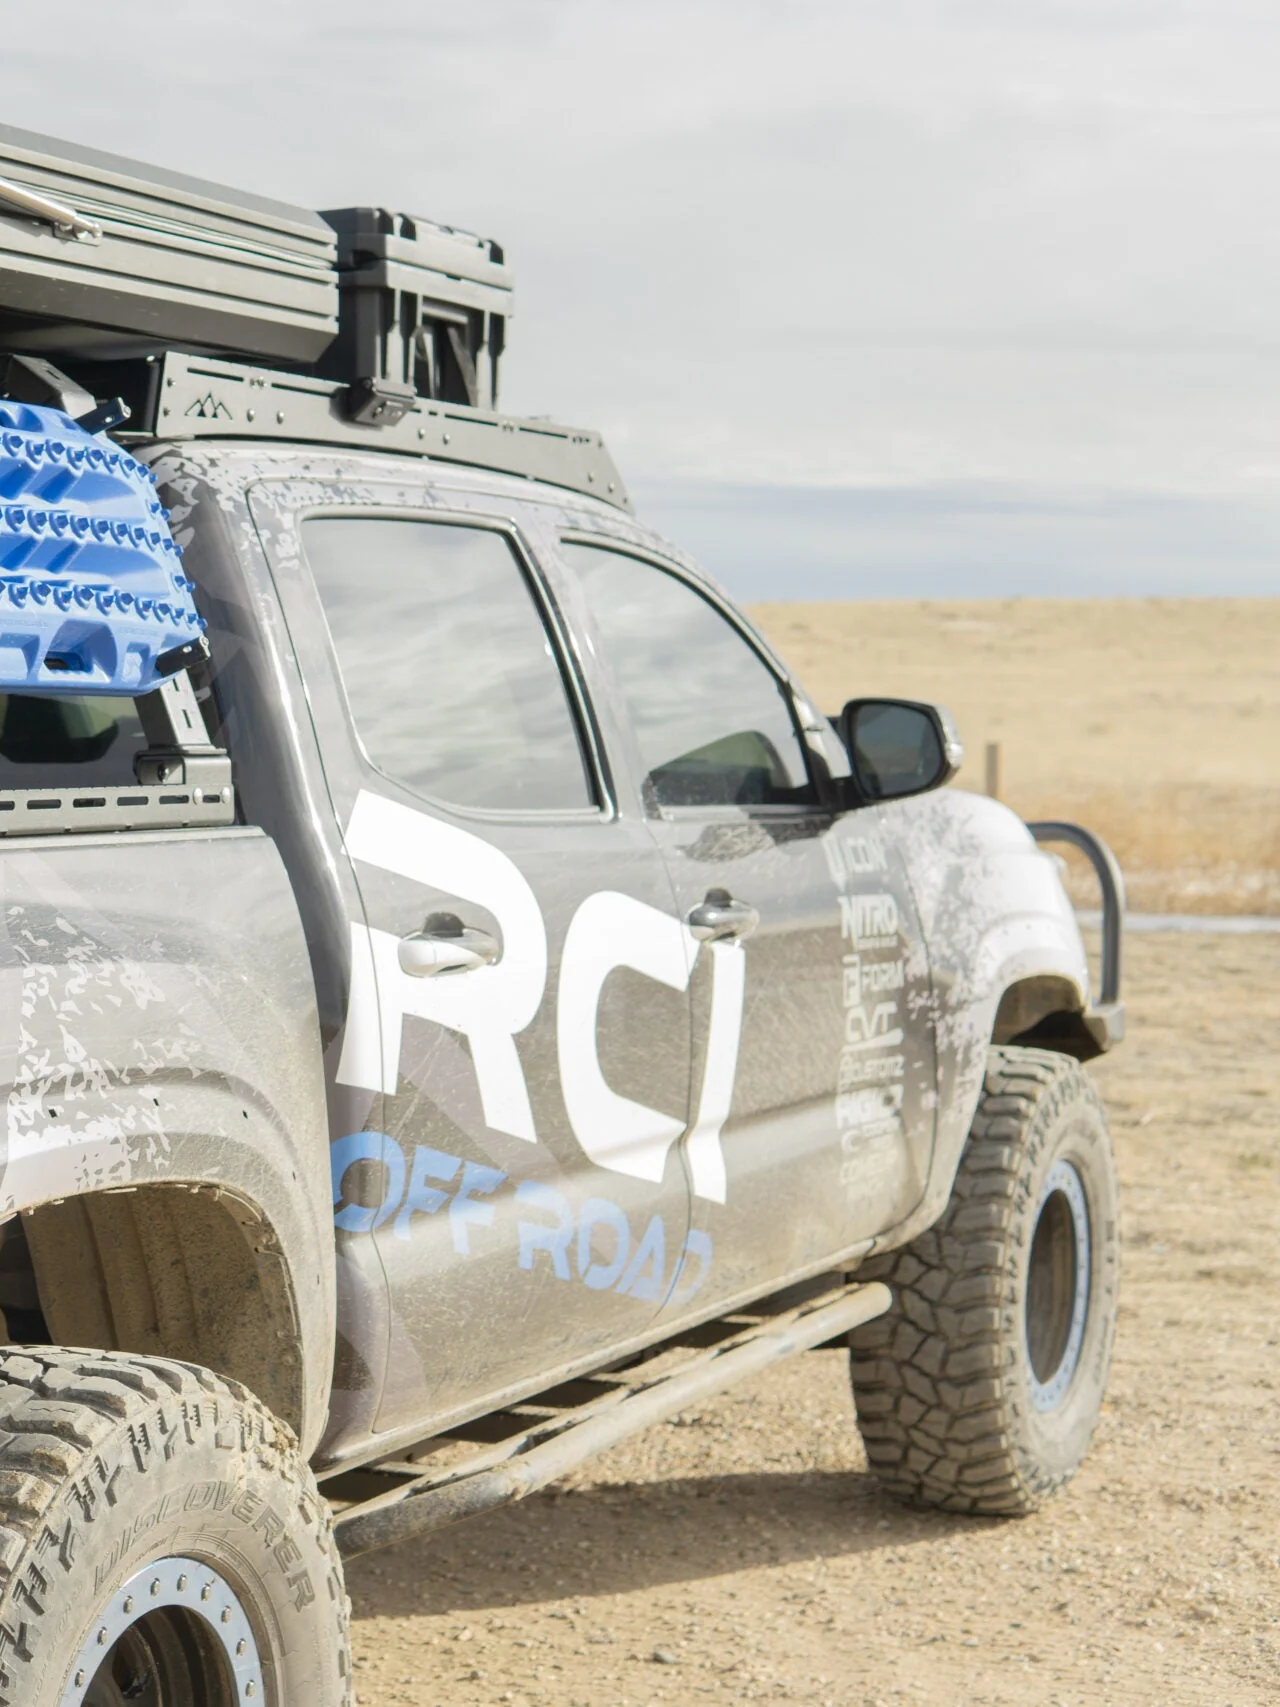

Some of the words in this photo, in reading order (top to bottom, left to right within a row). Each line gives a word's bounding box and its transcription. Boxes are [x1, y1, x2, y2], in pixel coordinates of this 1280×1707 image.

[838, 894, 897, 952] NITRO
[335, 788, 746, 1206] RCI
[845, 1001, 899, 1045] CVT
